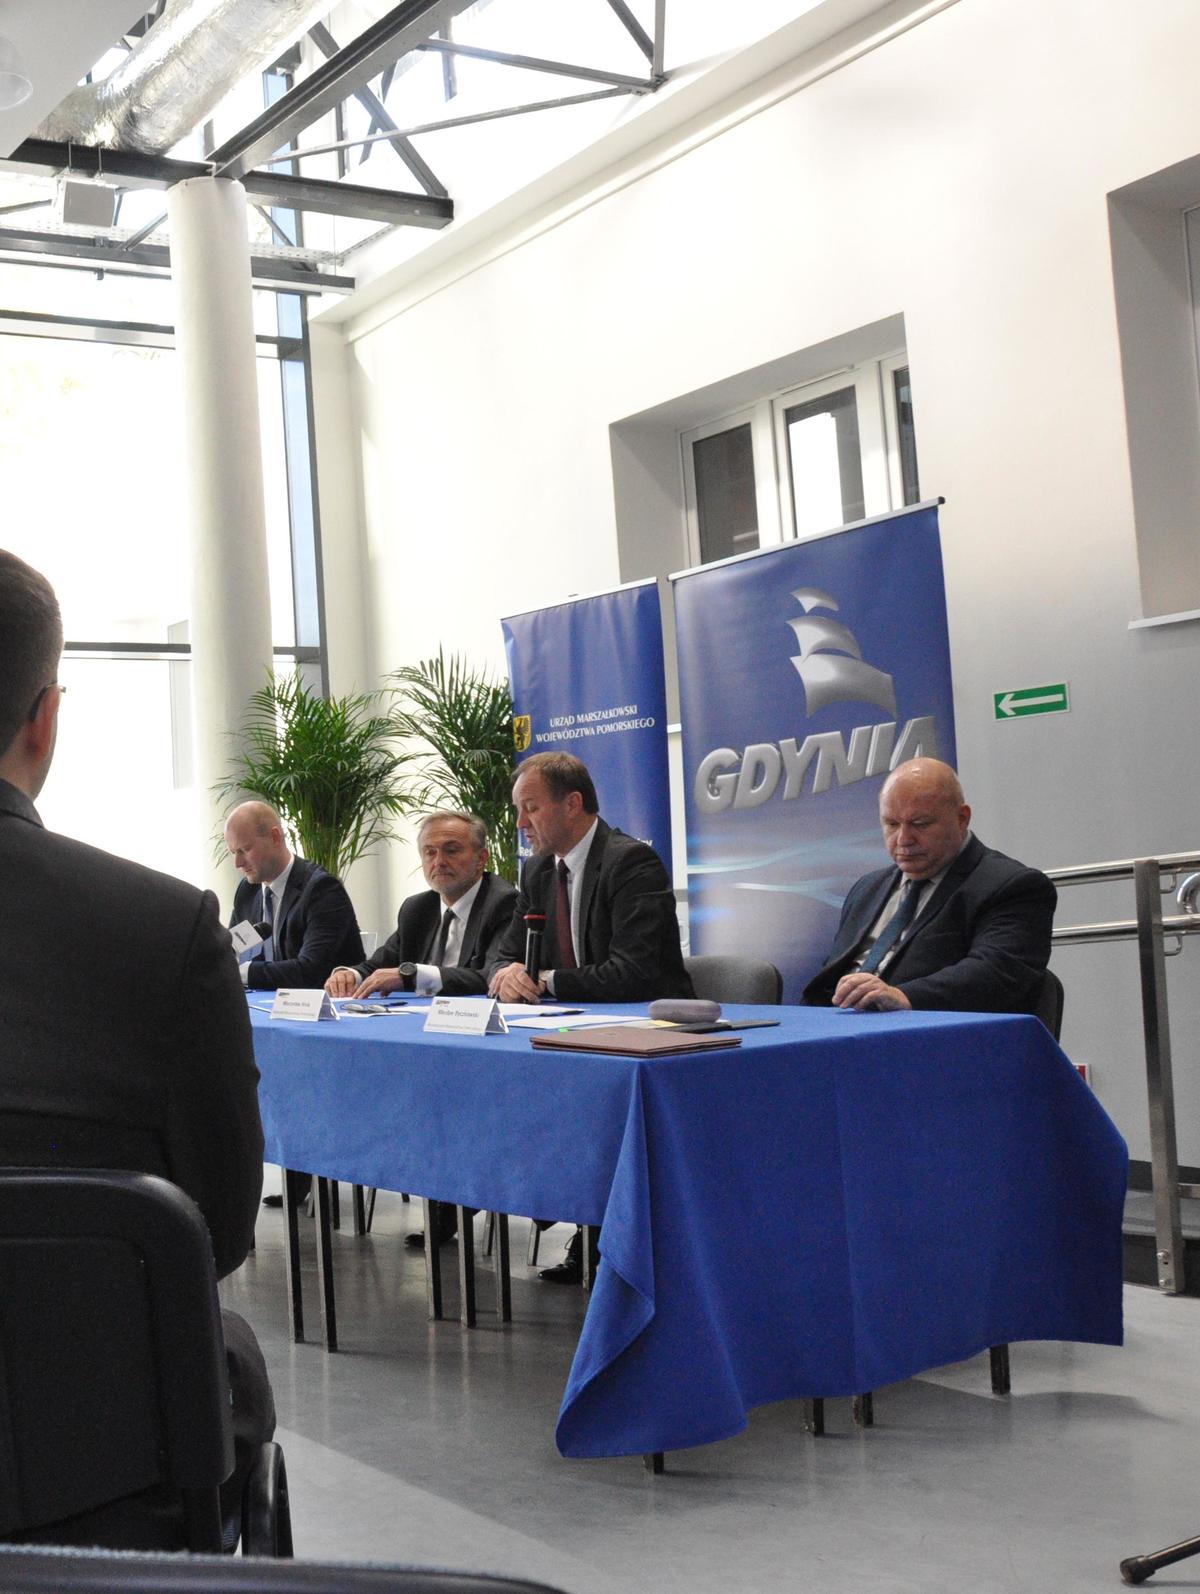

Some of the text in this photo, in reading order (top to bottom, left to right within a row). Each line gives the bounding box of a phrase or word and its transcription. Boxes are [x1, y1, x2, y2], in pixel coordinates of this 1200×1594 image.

[549, 705, 638, 728] URZĄD MARSZAŁKOWSKI
[536, 717, 655, 743] WOJEWÓDZTWA POMORSKIEGO
[694, 716, 938, 814] GDYNIA
